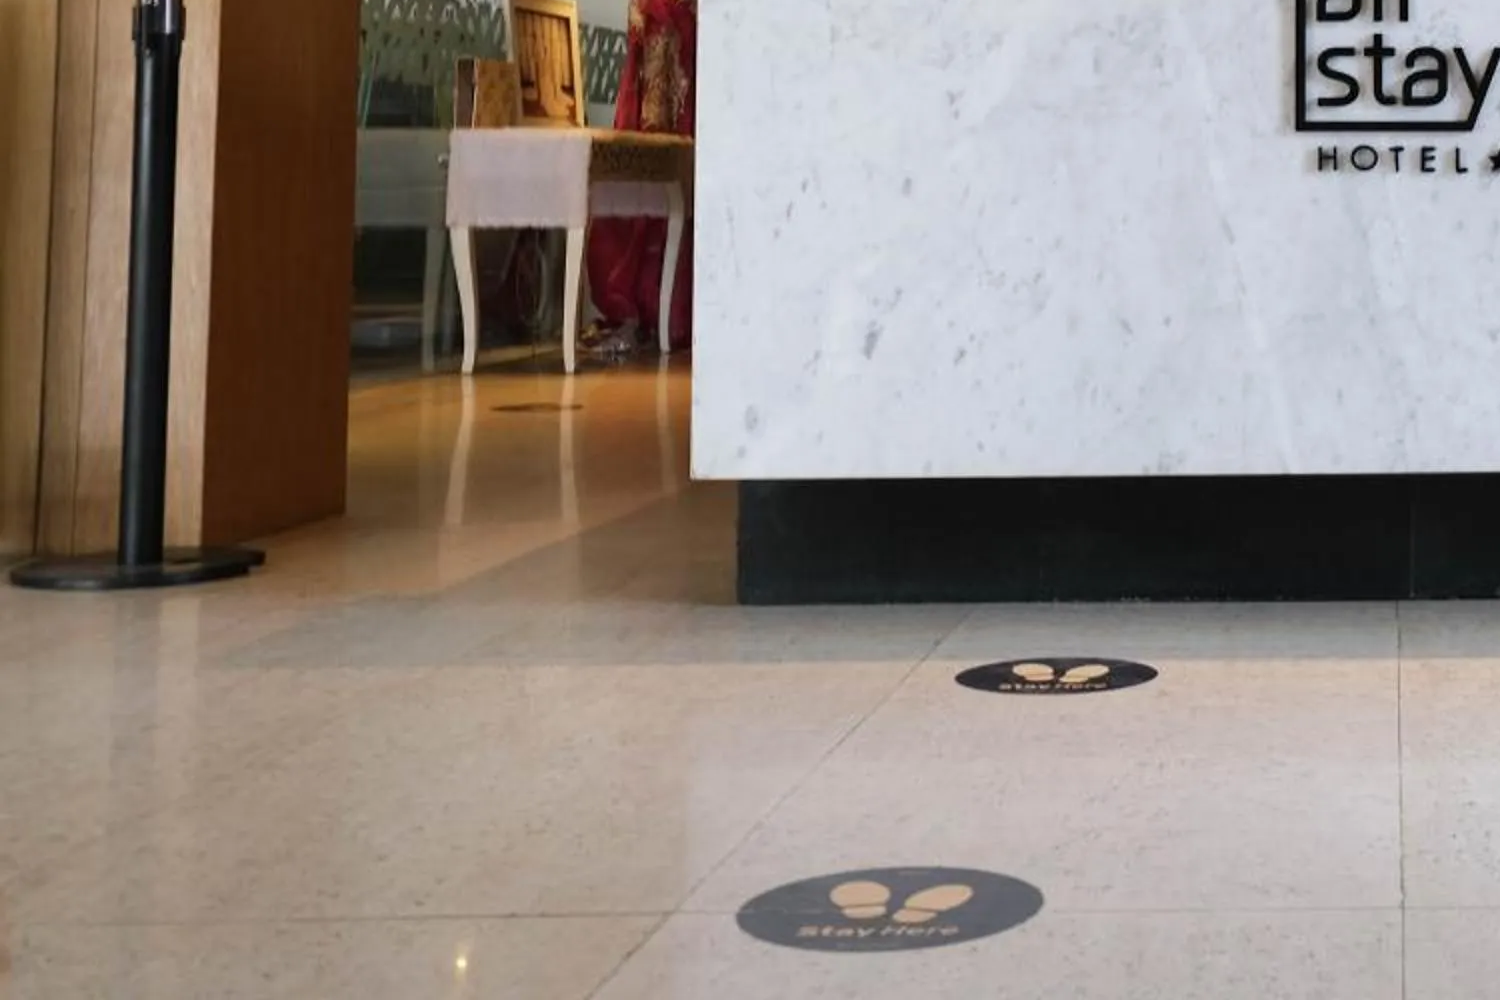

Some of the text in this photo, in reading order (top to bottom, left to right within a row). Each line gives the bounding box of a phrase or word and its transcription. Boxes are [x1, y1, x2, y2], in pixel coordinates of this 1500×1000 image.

[1317, 145, 1468, 173] HOTEL
[796, 925, 960, 938] Stay Here
